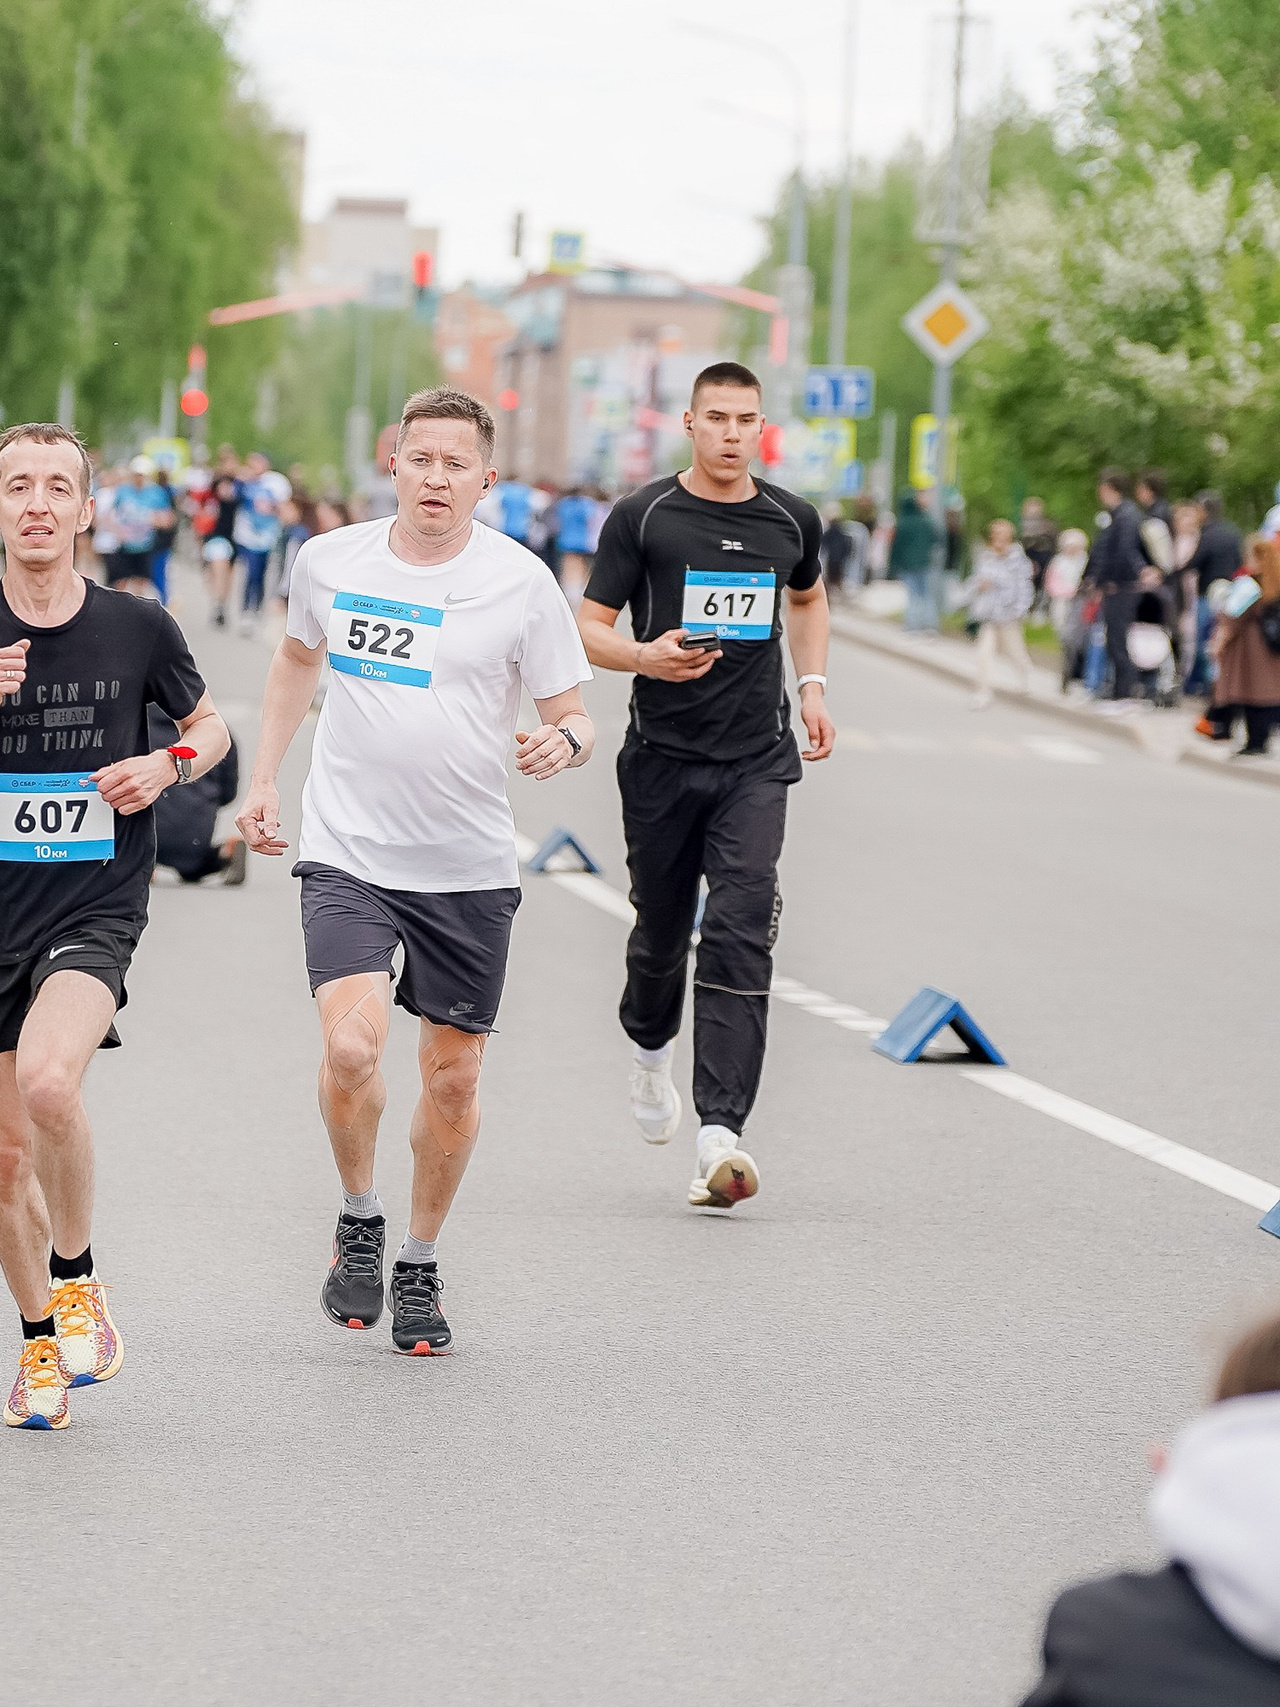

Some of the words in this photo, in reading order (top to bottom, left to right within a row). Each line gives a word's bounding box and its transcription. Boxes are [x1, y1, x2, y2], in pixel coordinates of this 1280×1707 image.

[703, 592, 757, 617] 617
[347, 618, 414, 660] 522
[36, 682, 79, 704] CAN
[94, 680, 120, 700] DO
[1, 713, 40, 728] MORE
[49, 709, 89, 723] THAN
[42, 729, 104, 752] THINK
[14, 799, 89, 834] 607
